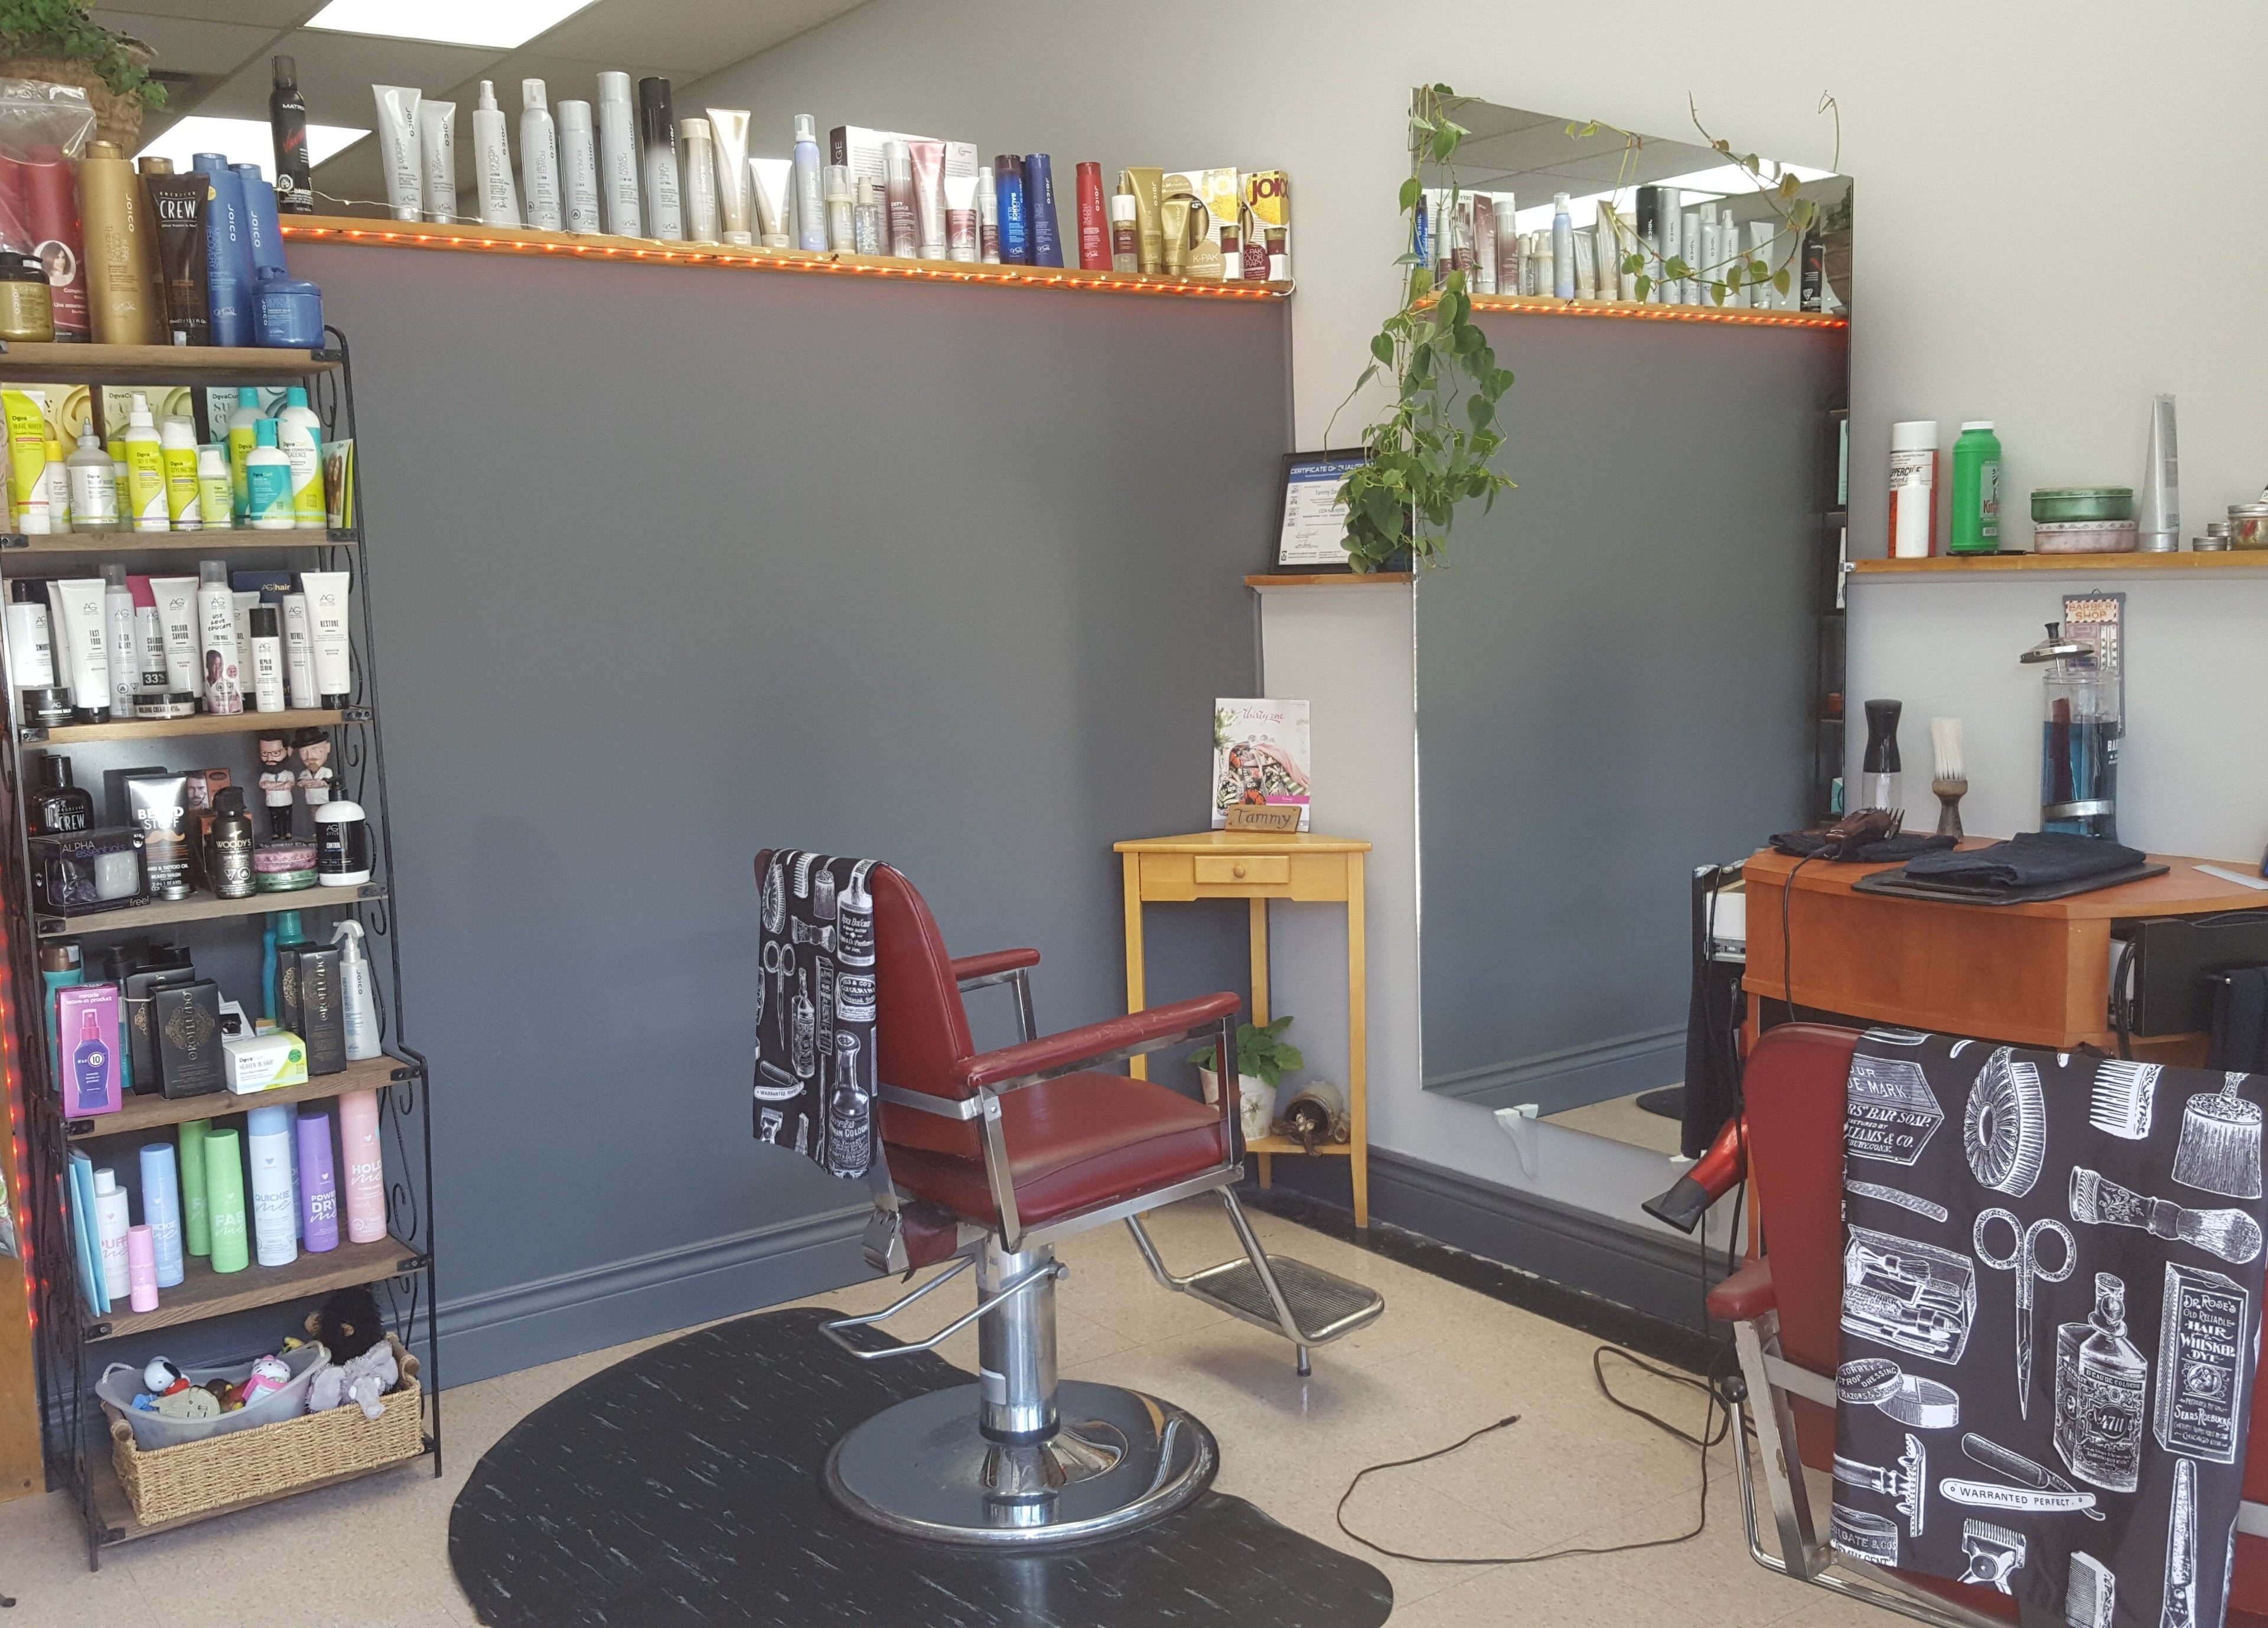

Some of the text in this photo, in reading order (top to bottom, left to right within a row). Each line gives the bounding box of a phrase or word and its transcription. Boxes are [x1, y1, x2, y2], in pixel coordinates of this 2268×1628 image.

[406, 108, 415, 137] JOICO
[126, 193, 135, 232] JOICO
[159, 200, 196, 219] CREW
[228, 204, 236, 242] JOICO
[251, 210, 260, 248] JOICO
[1193, 253, 1219, 262] K-PAK
[1290, 465, 1328, 475] CERTIFICATE
[83, 602, 98, 611] AG
[170, 598, 185, 607] AG
[211, 597, 226, 605] AG
[2069, 603, 2113, 611] BARBER
[115, 608, 129, 618] AG
[288, 606, 302, 615] AG
[2075, 611, 2107, 620] SHOP
[208, 623, 232, 631] EDUCATE
[1243, 706, 1285, 724] thirty one
[137, 806, 184, 819] BED
[1234, 808, 1291, 829] Tammy
[59, 813, 85, 831] CREW
[144, 817, 180, 830] STF
[62, 841, 95, 853] ALPHA
[76, 844, 126, 858] essentials
[216, 839, 252, 849] WOODY'S
[315, 954, 329, 1021] OROFLUIDO
[90, 995, 112, 1004] product
[183, 991, 198, 1060] OROFLUIDO
[92, 1055, 101, 1064] 10
[1847, 1103, 1932, 1127] RS' BAR SOAP.
[845, 1124, 868, 1137] COLOG
[1847, 1126, 1914, 1148] LIAMS & CO.
[255, 1190, 291, 1202] QUICKIE
[256, 1200, 291, 1212] me
[311, 1199, 336, 1213] DRY
[2201, 1294, 2237, 1314] ROSE'S
[2183, 1308, 2236, 1327] OLD RELIABLE
[2184, 1320, 2234, 1340] HAIR
[2179, 1333, 2237, 1357] WHISKER
[2186, 1349, 2224, 1363] DYE
[1860, 1366, 1898, 1388] DRESSING
[2104, 1375, 2113, 1384] DE
[2114, 1379, 2142, 1390] COLOGNE
[1841, 1388, 1868, 1400] RAZORS
[2174, 1404, 2198, 1421] SEARS
[2101, 1414, 2125, 1432] 4711
[1960, 1486, 2028, 1504] WARRANTED
[1871, 1539, 1879, 1549] &
